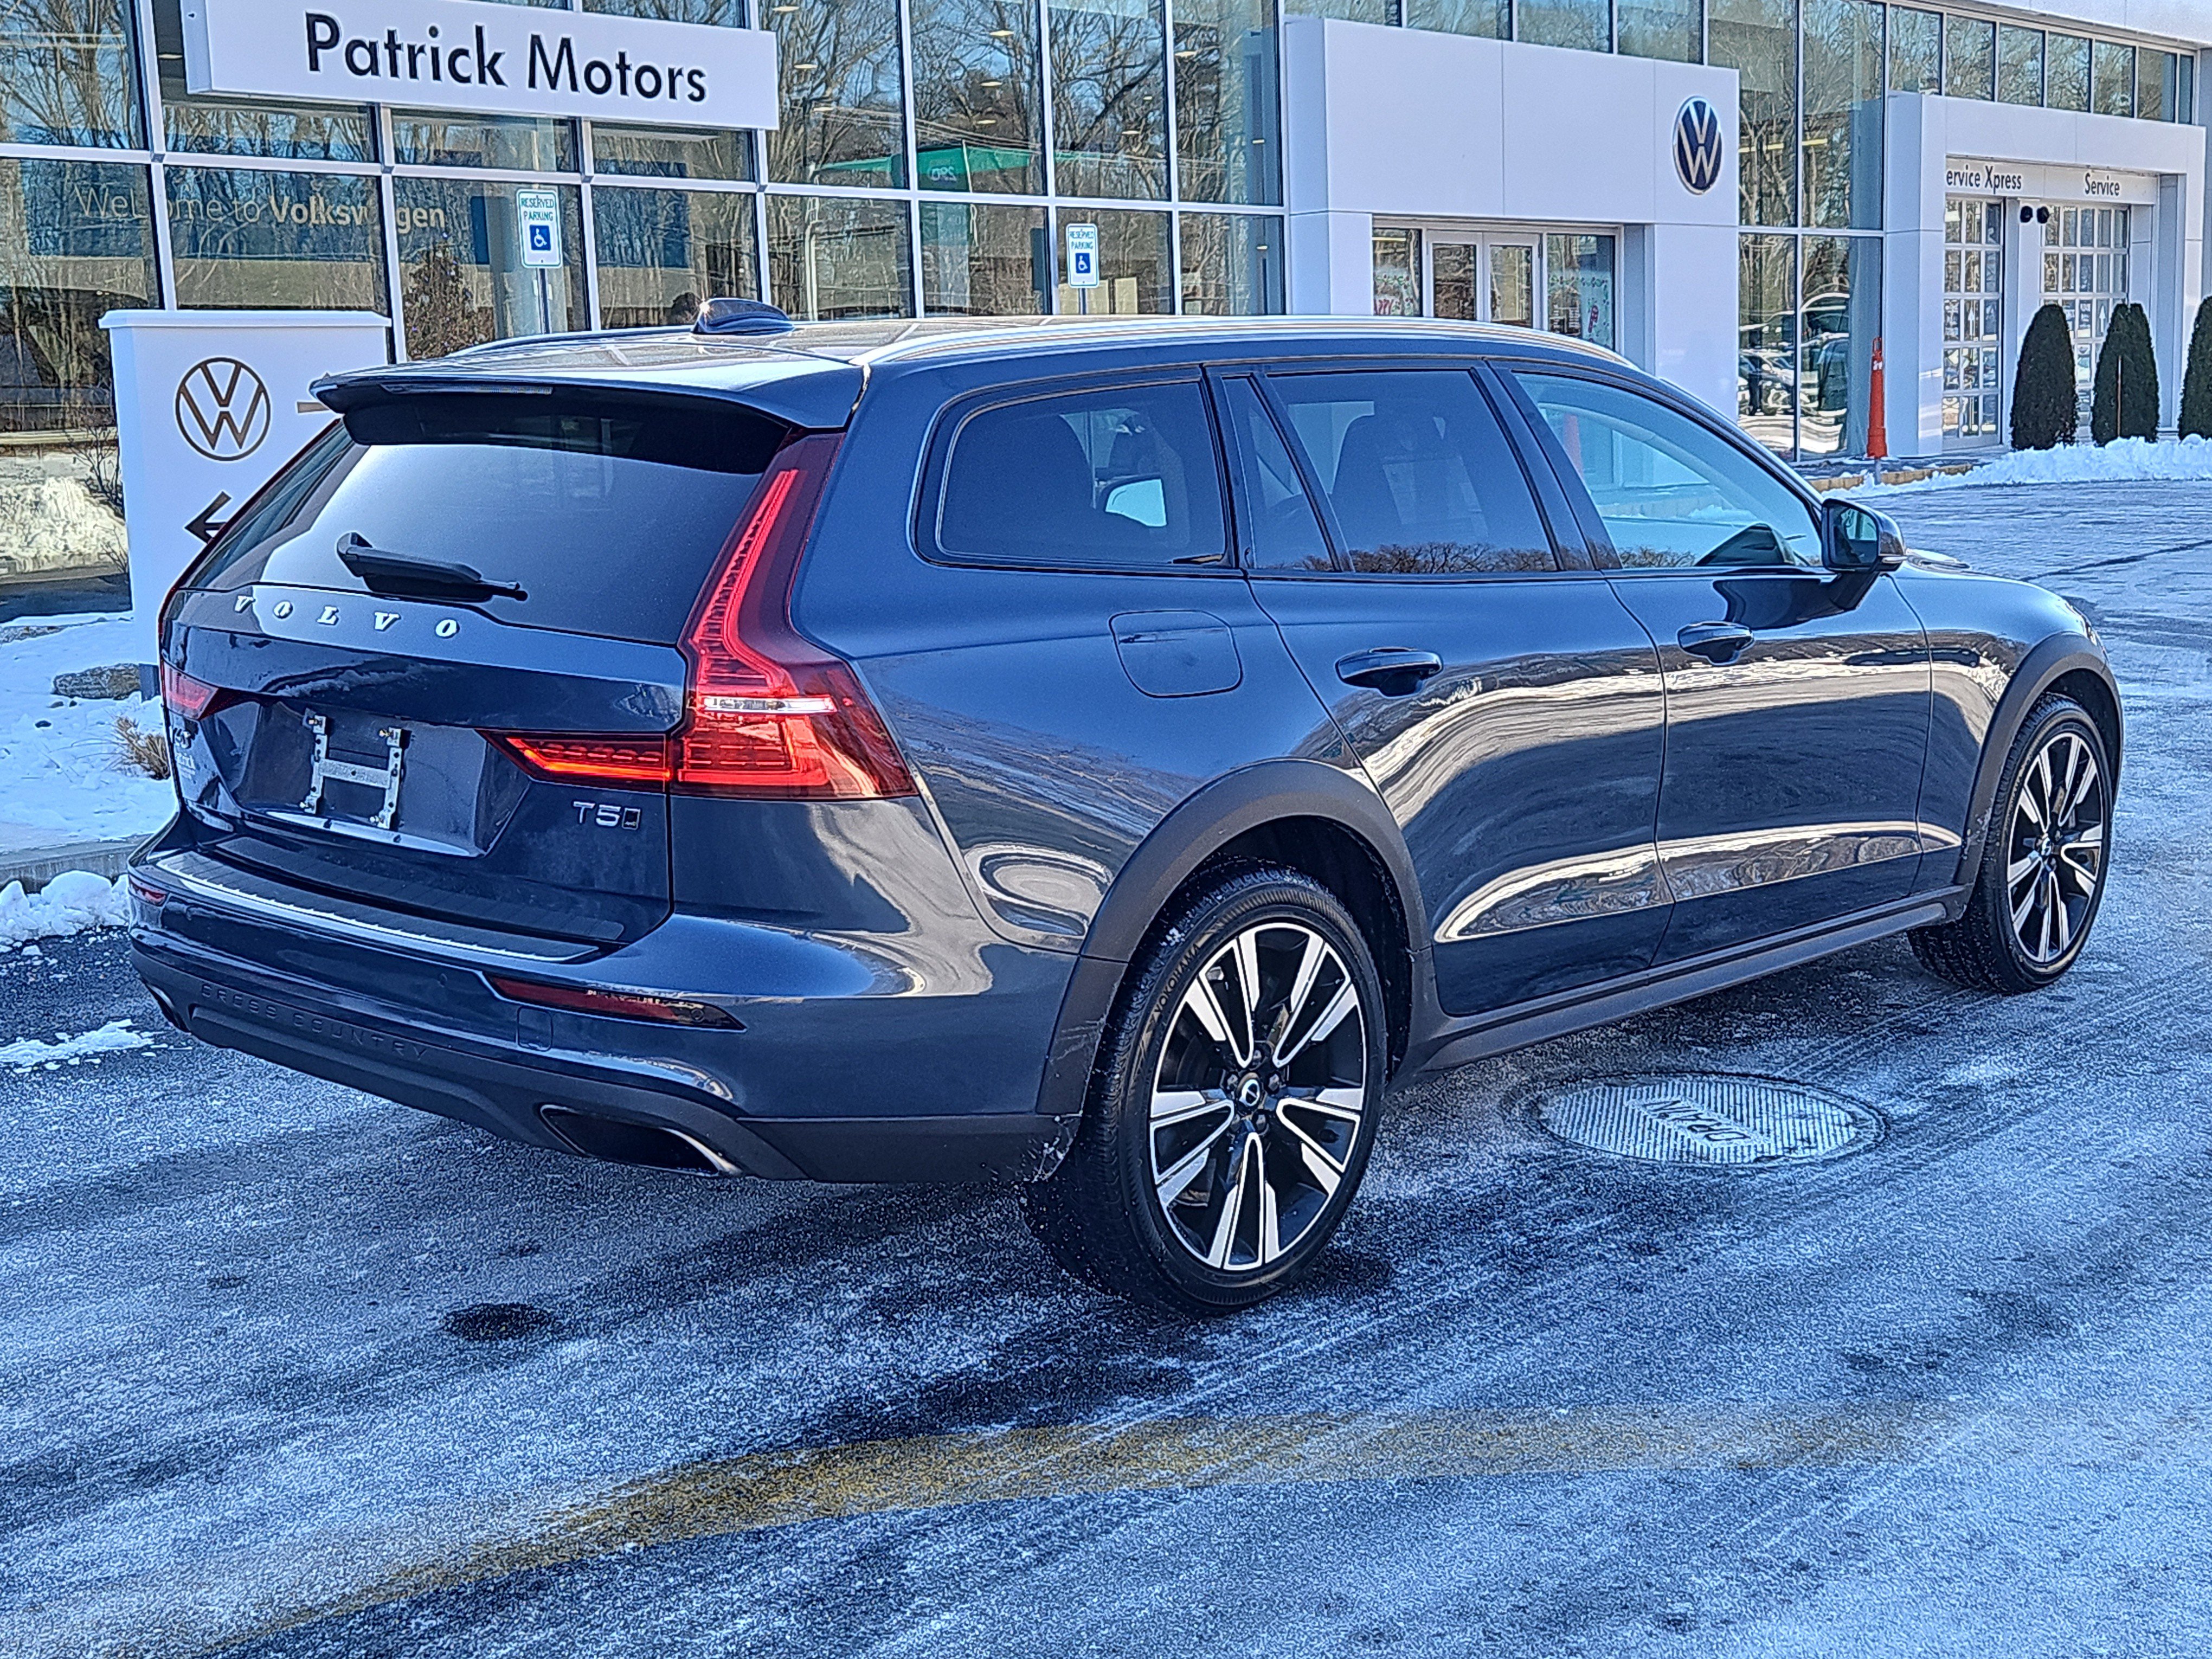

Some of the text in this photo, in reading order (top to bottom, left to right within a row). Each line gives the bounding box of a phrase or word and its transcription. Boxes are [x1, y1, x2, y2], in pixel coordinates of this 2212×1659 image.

[305, 10, 707, 102] Patrick Motors
[1946, 164, 2022, 195] ervice Xpress
[2085, 172, 2120, 196] Service
[74, 184, 445, 234] Welme to Volkswgen
[520, 197, 555, 209] RESERVED
[523, 210, 554, 221] PARKING
[1071, 241, 1094, 249] PARKING
[234, 595, 461, 639] VOLVO
[573, 801, 621, 827] T5
[1154, 943, 1200, 1013] YOKOHAMA
[201, 982, 428, 1061] CROSS COUNTRY
